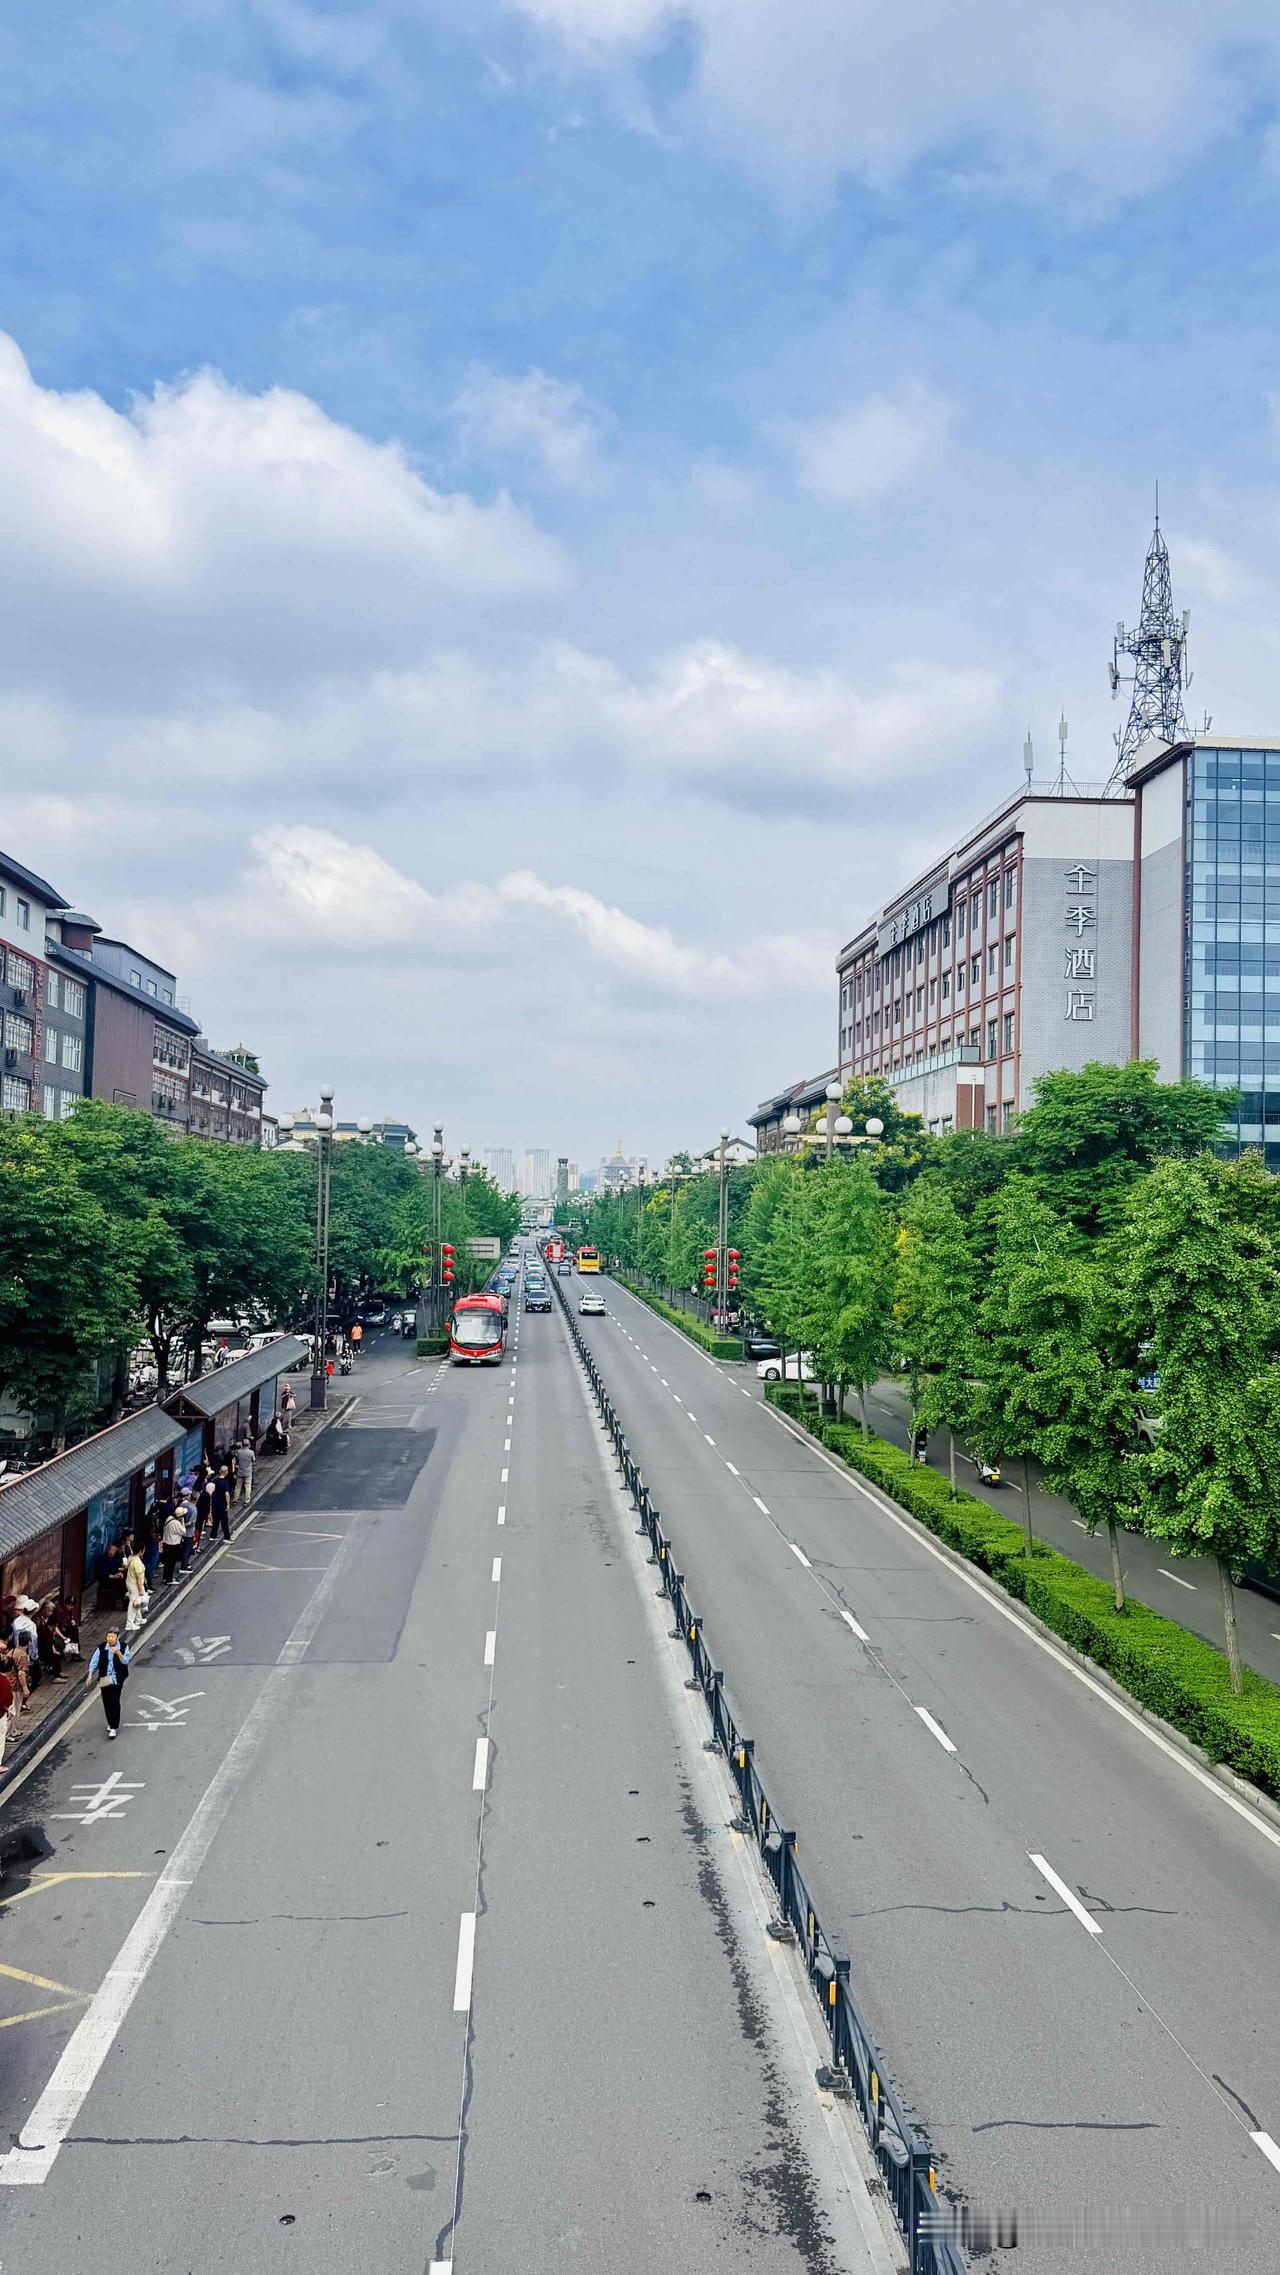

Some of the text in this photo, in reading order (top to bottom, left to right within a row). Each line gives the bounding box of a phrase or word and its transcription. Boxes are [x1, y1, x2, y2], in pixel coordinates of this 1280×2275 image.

[889, 894, 933, 948] 全季酒店
[1064, 863, 1097, 1021] 全季酒店
